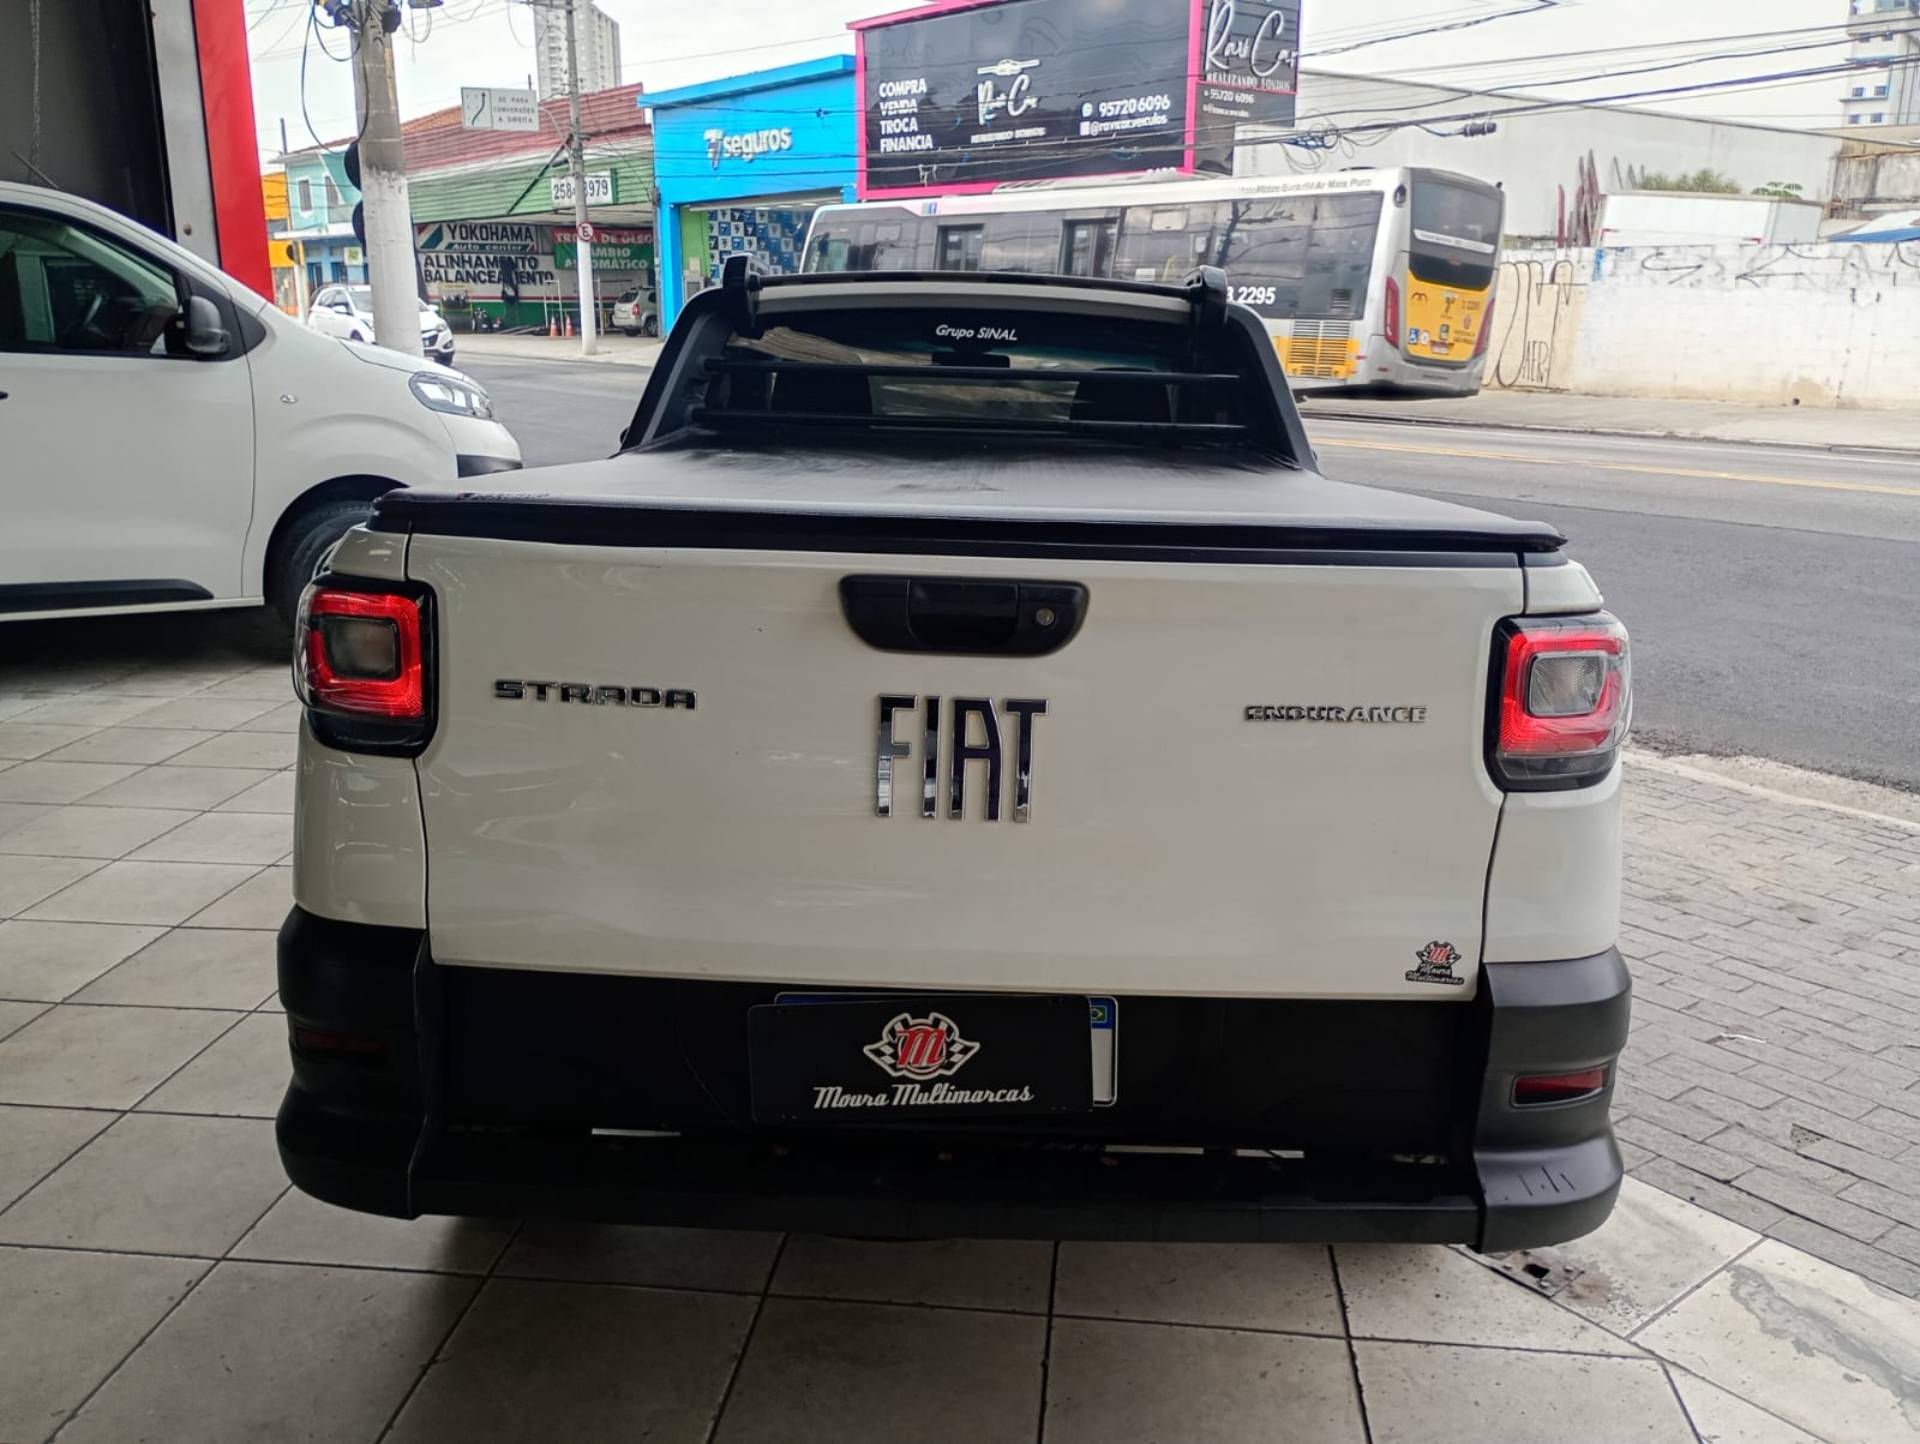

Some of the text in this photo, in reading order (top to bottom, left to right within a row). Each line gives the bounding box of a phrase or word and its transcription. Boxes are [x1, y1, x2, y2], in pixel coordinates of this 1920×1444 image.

[879, 78, 927, 97] COMPRA
[880, 98, 918, 116] VENDA
[1099, 94, 1171, 117] 95720 6096
[880, 117, 918, 135] TROCA
[723, 128, 793, 162] seguros
[880, 134, 933, 153] FINANCIA
[447, 224, 534, 241] YOKOHAMA
[601, 233, 617, 243] DE
[591, 247, 631, 258] AMBIO
[424, 254, 539, 270] ALINHAMNTO
[564, 256, 648, 269] AOMÁTICO
[1238, 286, 1276, 304] 2295
[935, 324, 1018, 341] Grupo SINAL
[495, 679, 697, 711] STRADA
[1245, 705, 1427, 723] ENDURANCE
[875, 692, 1049, 823] FIAT
[813, 1082, 1034, 1109] Moura Multimarcas
